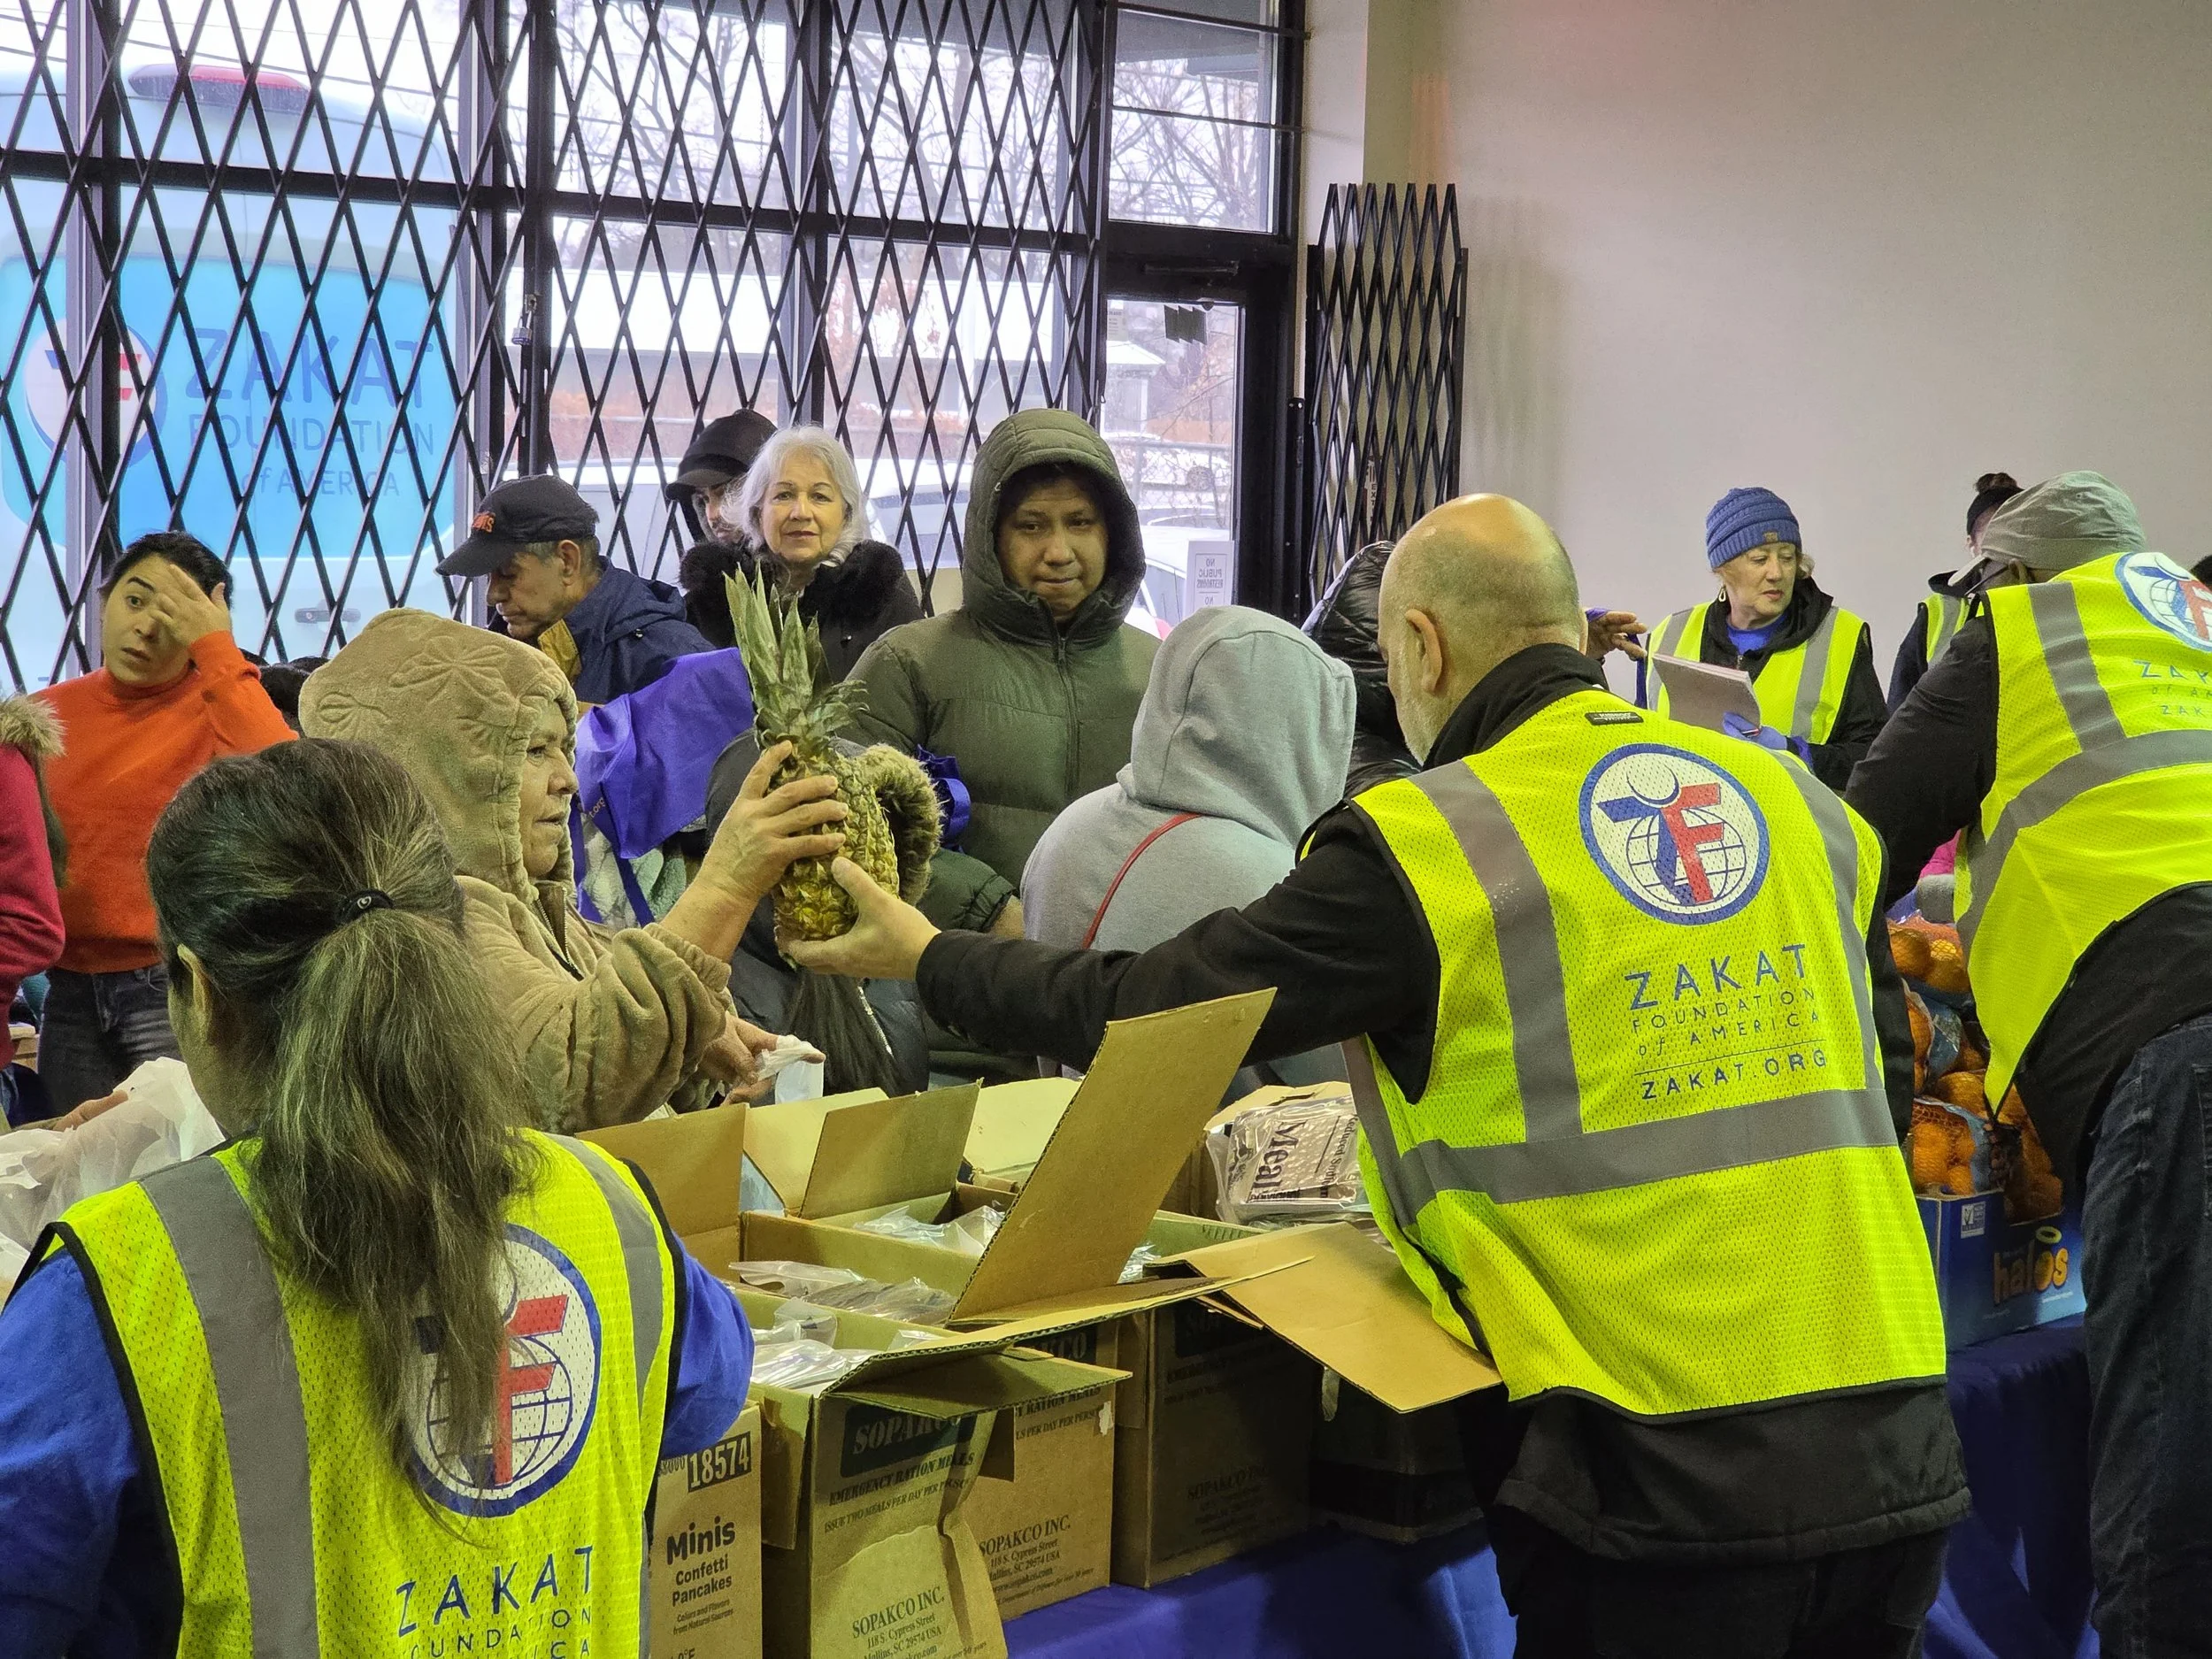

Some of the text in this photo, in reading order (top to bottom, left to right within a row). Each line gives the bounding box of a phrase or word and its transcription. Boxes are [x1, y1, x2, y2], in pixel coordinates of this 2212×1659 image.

[185, 328, 434, 408] ZAKAT
[188, 414, 433, 455] FOUNDTIN
[277, 471, 400, 495] AERCA
[1624, 943, 1806, 1010] ZAKAT
[1632, 989, 1816, 1033] FOUNDATION
[1639, 1011, 1821, 1056] of AMERICA
[1642, 1049, 1827, 1100] ZAKAT.ORG
[1252, 1119, 1308, 1188] Meal
[1993, 1240, 2070, 1306] halos
[853, 1416, 942, 1455] SOPAK
[689, 1436, 750, 1488] 18574
[829, 1474, 895, 1506] EMERGENCY
[896, 1459, 936, 1486] RATION
[847, 1509, 864, 1525] TWO
[864, 1502, 891, 1518] MEALS
[892, 1494, 907, 1508] PER
[907, 1488, 923, 1502] DAY
[923, 1484, 939, 1497] PER
[666, 1515, 736, 1565] Minis
[979, 1515, 1071, 1556] SOPAKCO INC.
[1011, 1546, 1037, 1562] Cypress
[1039, 1539, 1058, 1552] Street
[1045, 1550, 1060, 1563] USA
[396, 1545, 594, 1637] ZAKAT
[672, 1576, 732, 1607] Pancakes
[675, 1554, 728, 1586] Confetti
[411, 1608, 591, 1659] UNDAION
[852, 1586, 945, 1639] SOPAKCO INC.
[867, 1636, 879, 1649] 118
[888, 1623, 915, 1641] Cypress
[916, 1613, 936, 1626] Street
[894, 1640, 905, 1654] SC
[906, 1633, 926, 1649] 29574
[926, 1625, 942, 1640] USA
